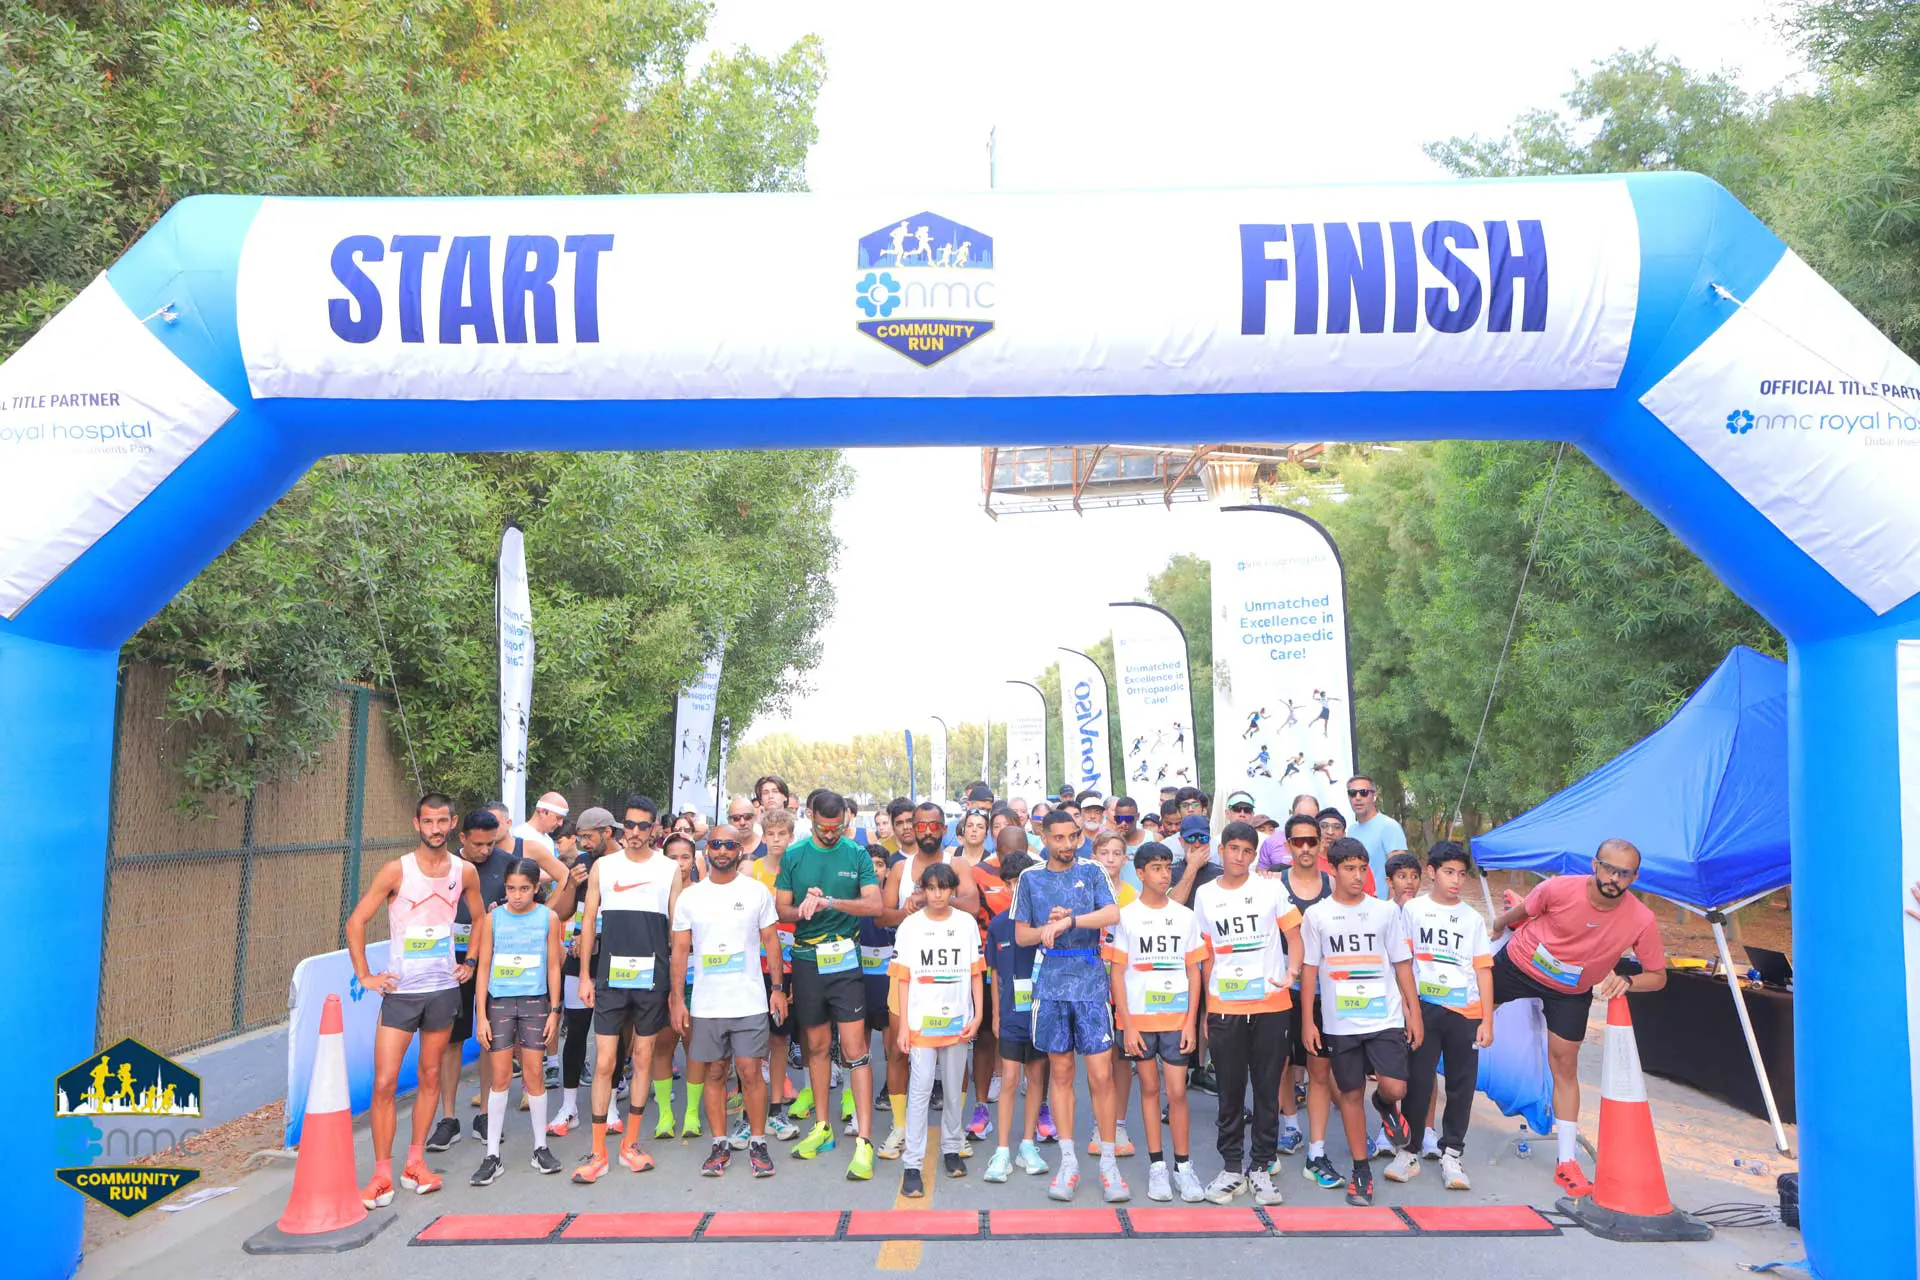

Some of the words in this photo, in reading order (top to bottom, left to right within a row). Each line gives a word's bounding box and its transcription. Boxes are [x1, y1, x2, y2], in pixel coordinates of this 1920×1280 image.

[1239, 219, 1549, 336] FINISH
[328, 234, 614, 345] START
[905, 281, 996, 309] nmc
[877, 323, 975, 338] COMMUNITY
[908, 337, 944, 351] RUN
[1759, 379, 1835, 396] OFFICIAL
[1839, 380, 1879, 397] TITLE
[12, 394, 47, 409] TITLE
[50, 392, 121, 408] PARTNER
[52, 420, 152, 443] hospital
[1754, 413, 1814, 431] nmc
[1819, 411, 1880, 435] royal
[1244, 594, 1329, 612] Unmatched
[1240, 613, 1317, 629] Excellence
[1322, 611, 1334, 624] in
[1242, 628, 1334, 646] Orthopaedic
[1270, 647, 1306, 661] Care!
[1126, 660, 1181, 673] Unmatched
[1124, 674, 1173, 685] Excellence
[1216, 914, 1259, 937] MST
[1139, 935, 1182, 954] MST
[1329, 933, 1376, 952] MST
[1420, 927, 1464, 950] MST
[920, 948, 961, 966] MST
